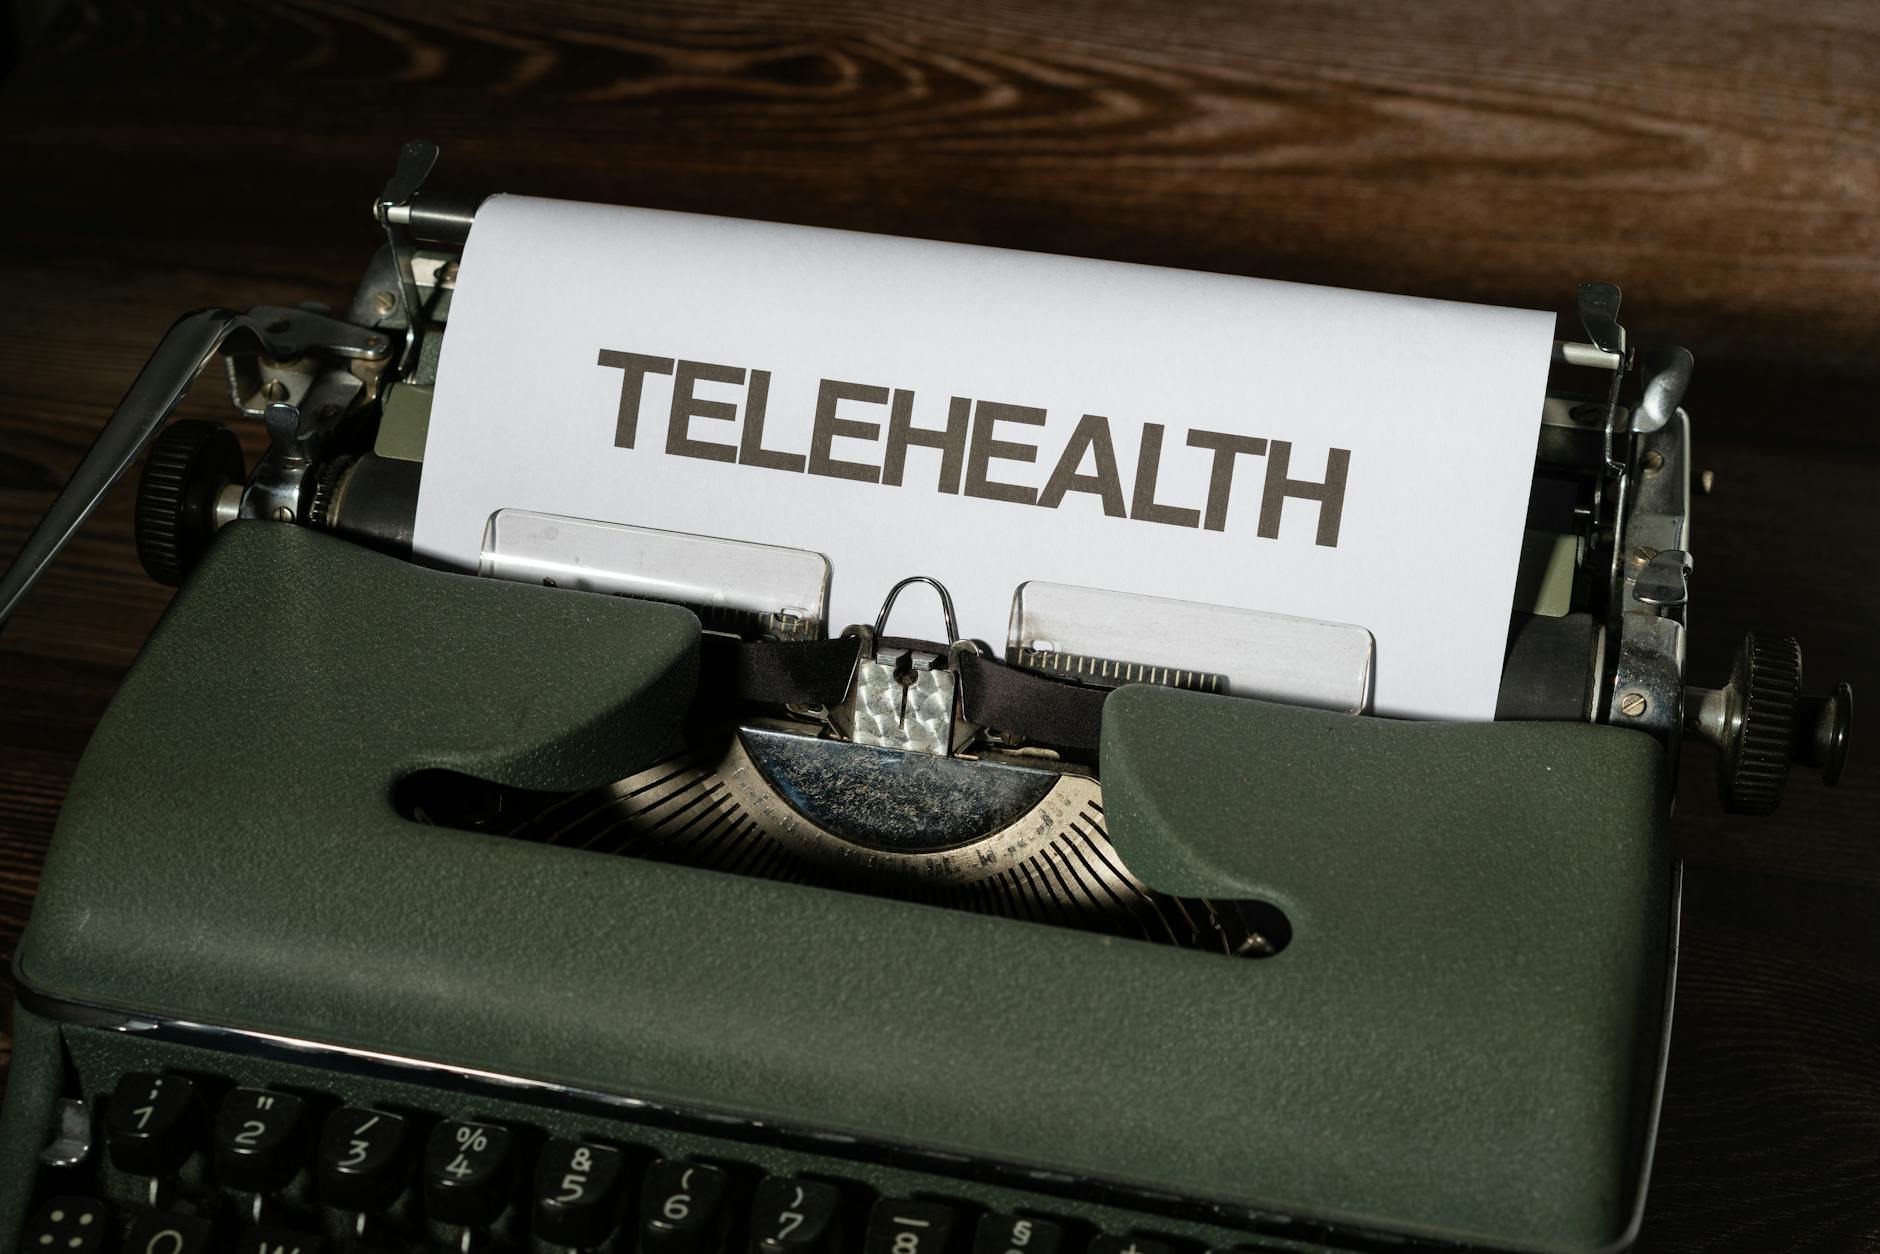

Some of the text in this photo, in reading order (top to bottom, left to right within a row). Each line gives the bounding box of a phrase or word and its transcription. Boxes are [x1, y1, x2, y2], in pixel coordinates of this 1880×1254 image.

[598, 349, 1350, 547] TELEHEALTH
[134, 1106, 154, 1130] 1
[235, 1121, 266, 1145] 2
[456, 1127, 488, 1152] %
[337, 1140, 370, 1167] 3
[446, 1153, 473, 1179] 4
[570, 1148, 593, 1172] &
[556, 1174, 588, 1202] 5
[663, 1194, 691, 1220] 6
[778, 1211, 805, 1240] 7
[892, 1232, 919, 1254] 8
